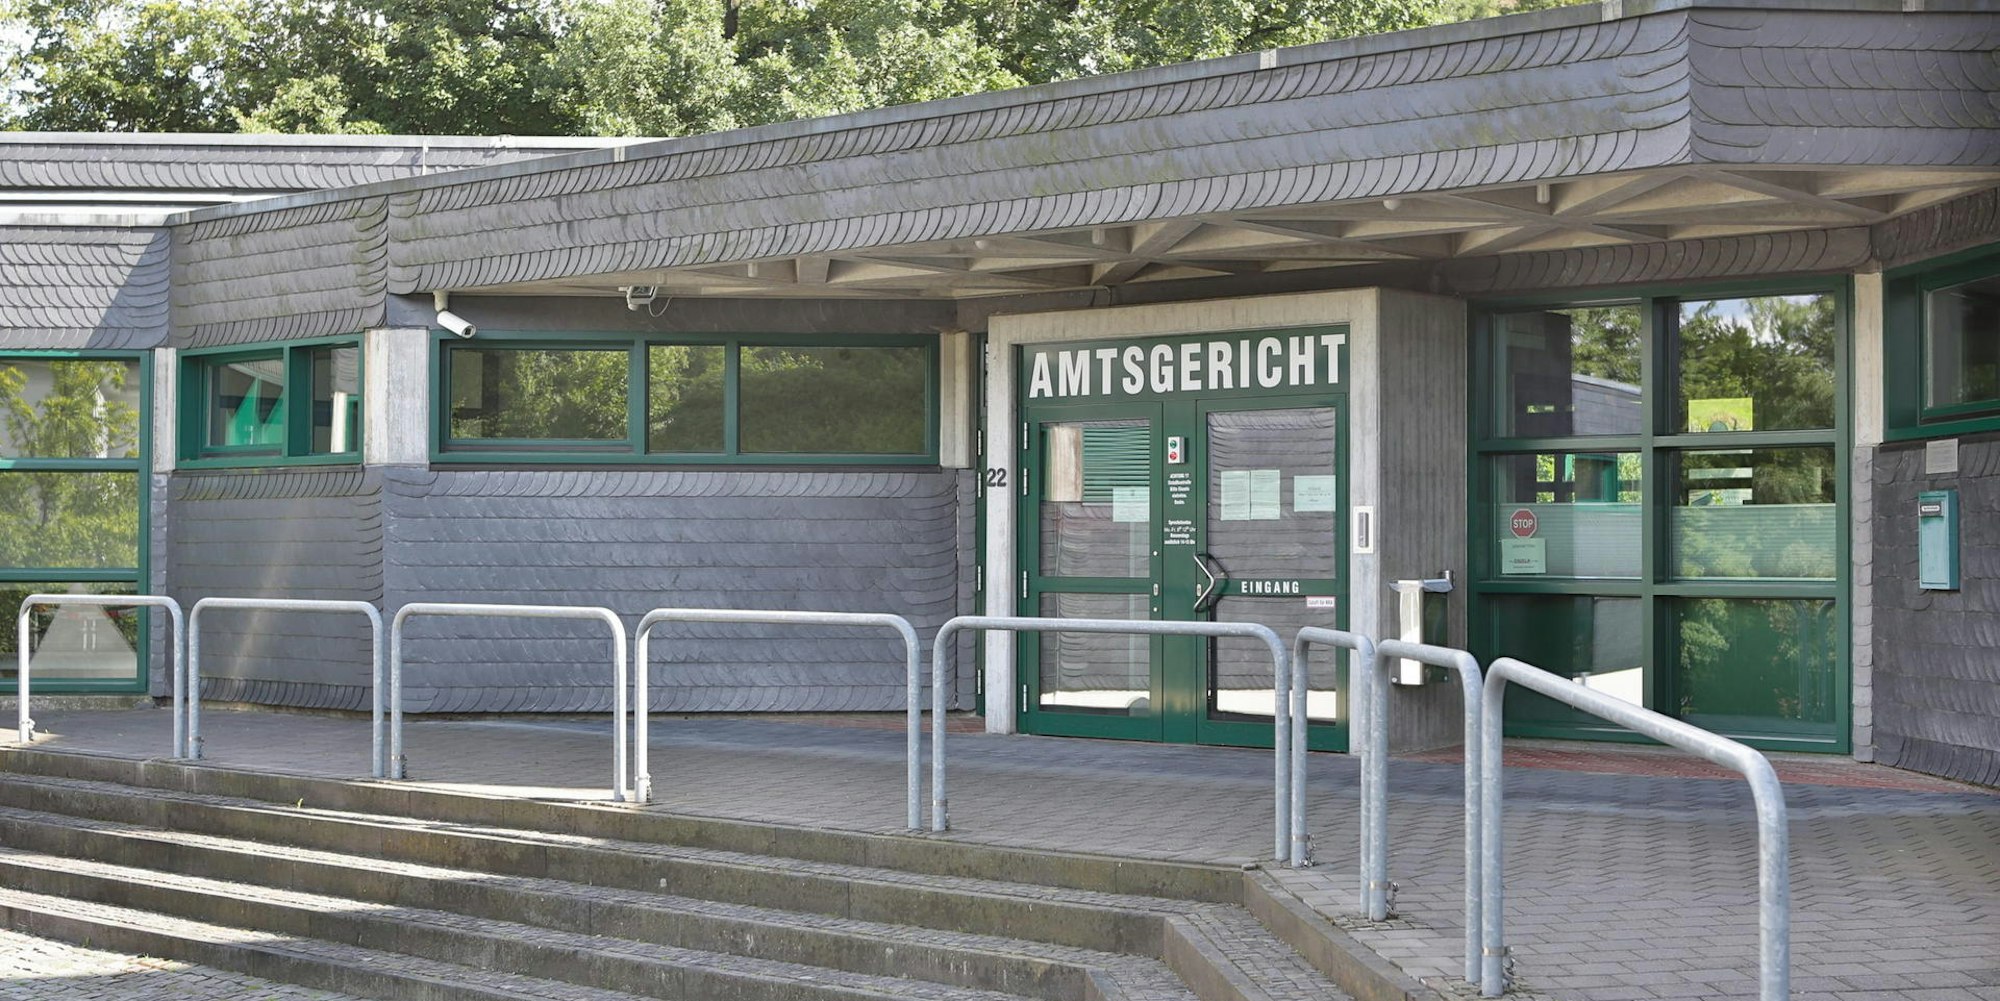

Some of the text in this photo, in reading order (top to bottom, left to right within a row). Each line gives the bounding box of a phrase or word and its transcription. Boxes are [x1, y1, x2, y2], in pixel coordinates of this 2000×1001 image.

[1029, 334, 1345, 398] AMTSGERICHT
[986, 467, 1007, 487] 22
[1513, 519, 1533, 528] STOP
[1241, 581, 1300, 593] EINGANG
